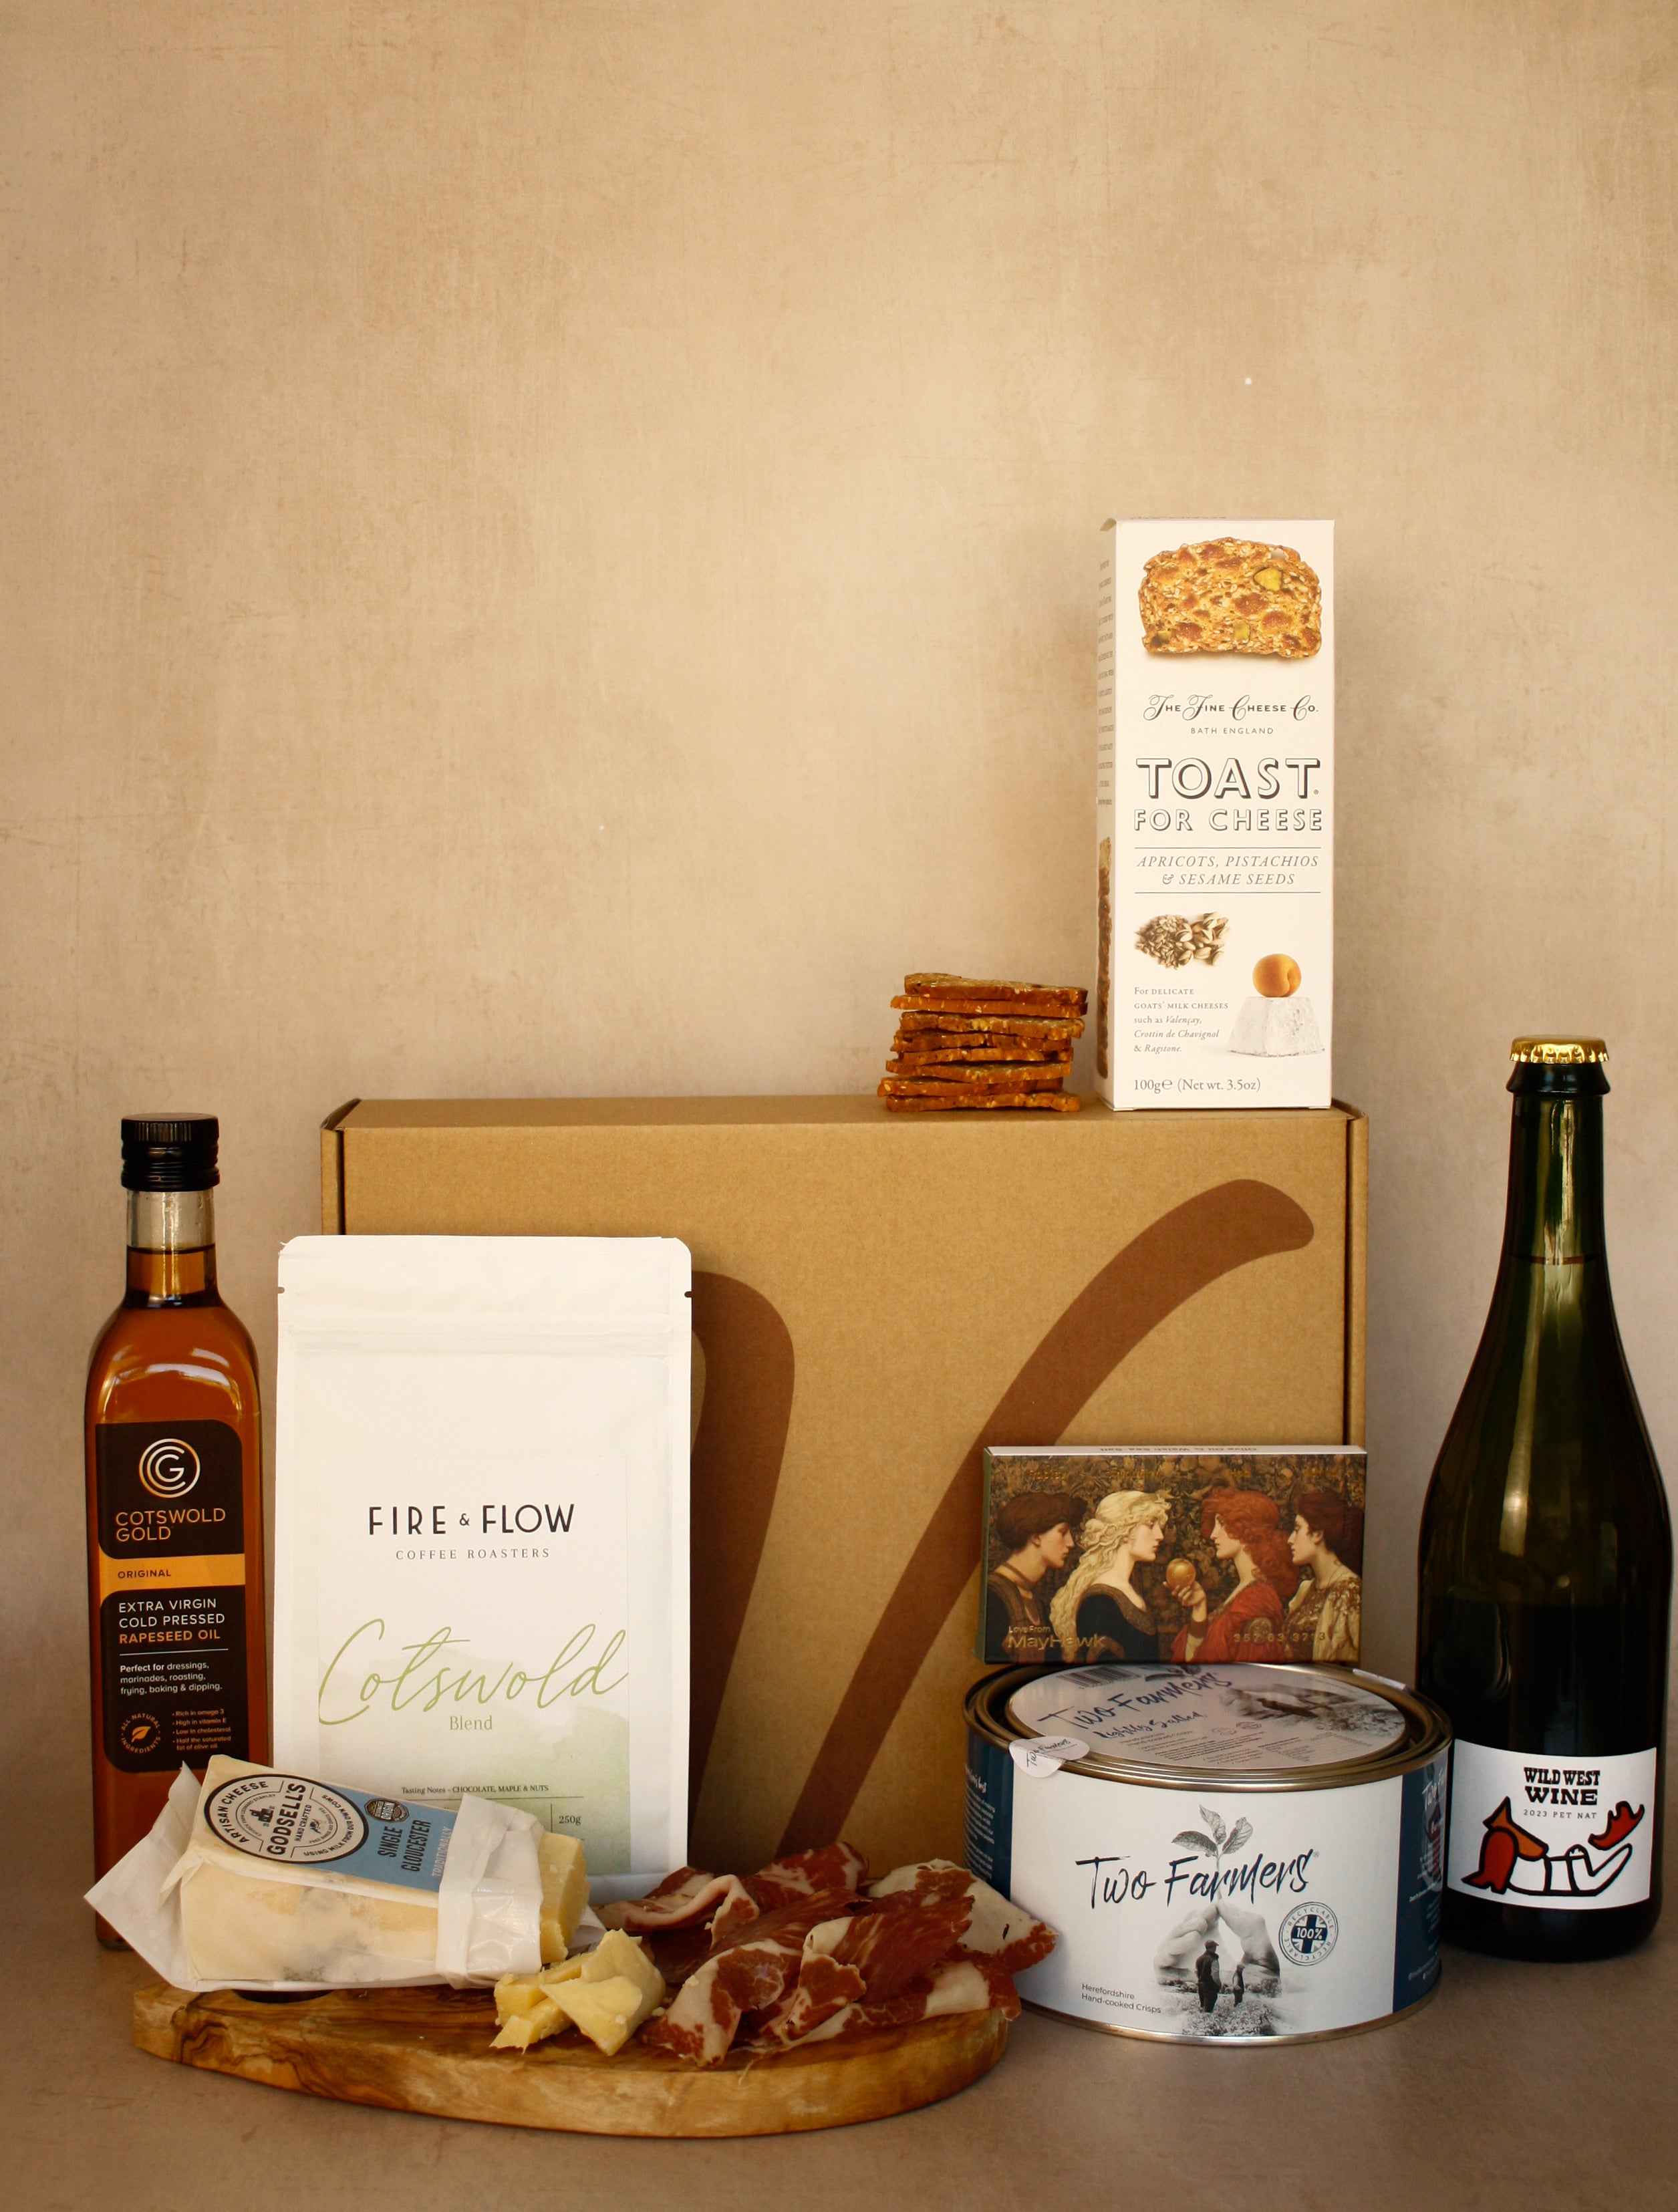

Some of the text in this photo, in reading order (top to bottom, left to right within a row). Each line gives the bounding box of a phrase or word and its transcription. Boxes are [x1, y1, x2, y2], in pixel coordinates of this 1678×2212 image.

[1134, 809, 1322, 831] FOR CHEESE
[1136, 855, 1318, 868] APRICOTS, PISTACHIOS
[1162, 873, 1295, 885] & SESAME SEEDS
[1134, 987, 1149, 995] For
[1134, 1015, 1153, 1024] such
[1165, 1016, 1203, 1026] Valençay,
[1134, 1030, 1220, 1041] Crottin de Chavignol
[1134, 1045, 1183, 1055] & Ragstone.
[1177, 1078, 1204, 1093] (Net
[1206, 1080, 1224, 1091] wt.
[1226, 1078, 1261, 1093] 3.5oz)
[116, 1508, 226, 1526] COTSWOLD
[368, 1504, 575, 1535] FIRE & FLOW
[116, 1526, 172, 1542] GOLD
[396, 1548, 550, 1560] COFFEE ROASTERS
[118, 1569, 172, 1579] ORIGINAL
[119, 1598, 217, 1613] EXTRA VIRGIN
[119, 1613, 225, 1629] COLD PRESSED
[119, 1629, 221, 1644] RAPESEED OIL
[1008, 1634, 1106, 1651] MayHawk
[120, 1664, 151, 1672] Perfect
[167, 1661, 209, 1670] dressings,
[319, 1618, 629, 1725] Cotswold
[120, 1673, 206, 1683] marinades, roasting,
[149, 1685, 178, 1693] baking
[180, 1683, 186, 1691] &
[188, 1683, 223, 1692] dipping.
[1036, 1672, 1233, 1730] Two Farmers
[121, 1713, 160, 1731] ALL NATURAL
[449, 1714, 493, 1730] Blend
[121, 1737, 161, 1754] INGREDIENTS
[1524, 1767, 1600, 1786] WILD WEST
[402, 1786, 425, 1795] Tasting
[1524, 1786, 1598, 1806] WINE
[321, 1794, 341, 1808] COWS
[217, 1781, 269, 1843] ARTISAN CHEESE
[299, 1804, 312, 1828] CRAFTED
[339, 1808, 352, 1820] OWN
[380, 1802, 396, 1820] ORIGIN
[1524, 1809, 1548, 1818] 2023
[1553, 1811, 1571, 1819] PET
[267, 1783, 306, 1855] GODSELL'S
[347, 1820, 355, 1830] OUR
[559, 1815, 581, 1825] 250g
[341, 1830, 354, 1842] FROM
[378, 1826, 403, 1857] SINGLE
[328, 1842, 345, 1851] MILK
[401, 1820, 431, 1872] GLOUCESTER
[1075, 1848, 1314, 1909] Two Farmers
[1287, 1907, 1335, 1929] RECYCLABLE
[1296, 1927, 1323, 1940] 100%
[1081, 1983, 1135, 1999] Herefordshire
[1081, 1993, 1161, 2014] Hand-cooked Crisps
